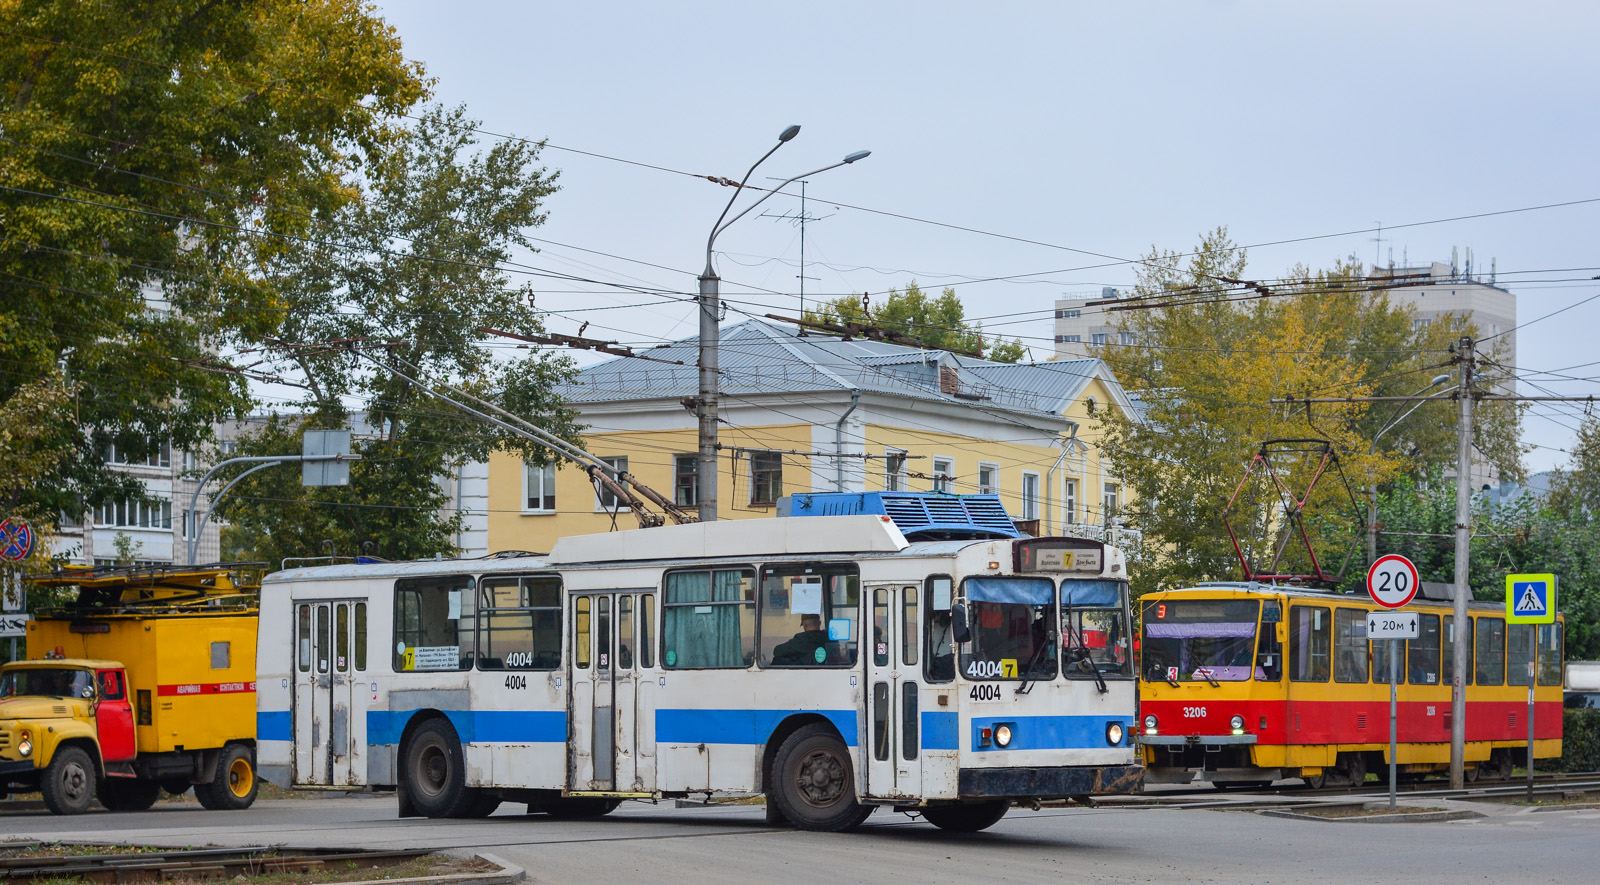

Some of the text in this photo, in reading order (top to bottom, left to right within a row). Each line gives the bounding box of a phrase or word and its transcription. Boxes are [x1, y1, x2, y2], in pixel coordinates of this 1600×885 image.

[1065, 554, 1072, 565] 7
[1379, 571, 1408, 591] 20
[1157, 604, 1166, 619] 3
[1382, 620, 1405, 631] 20м
[407, 653, 413, 665] 7
[506, 652, 532, 667] 4004
[967, 661, 1013, 677] 4004 7
[1169, 667, 1177, 680] 3
[505, 675, 527, 690] 4004
[970, 684, 1001, 701] 4004
[1183, 707, 1207, 718] 3206
